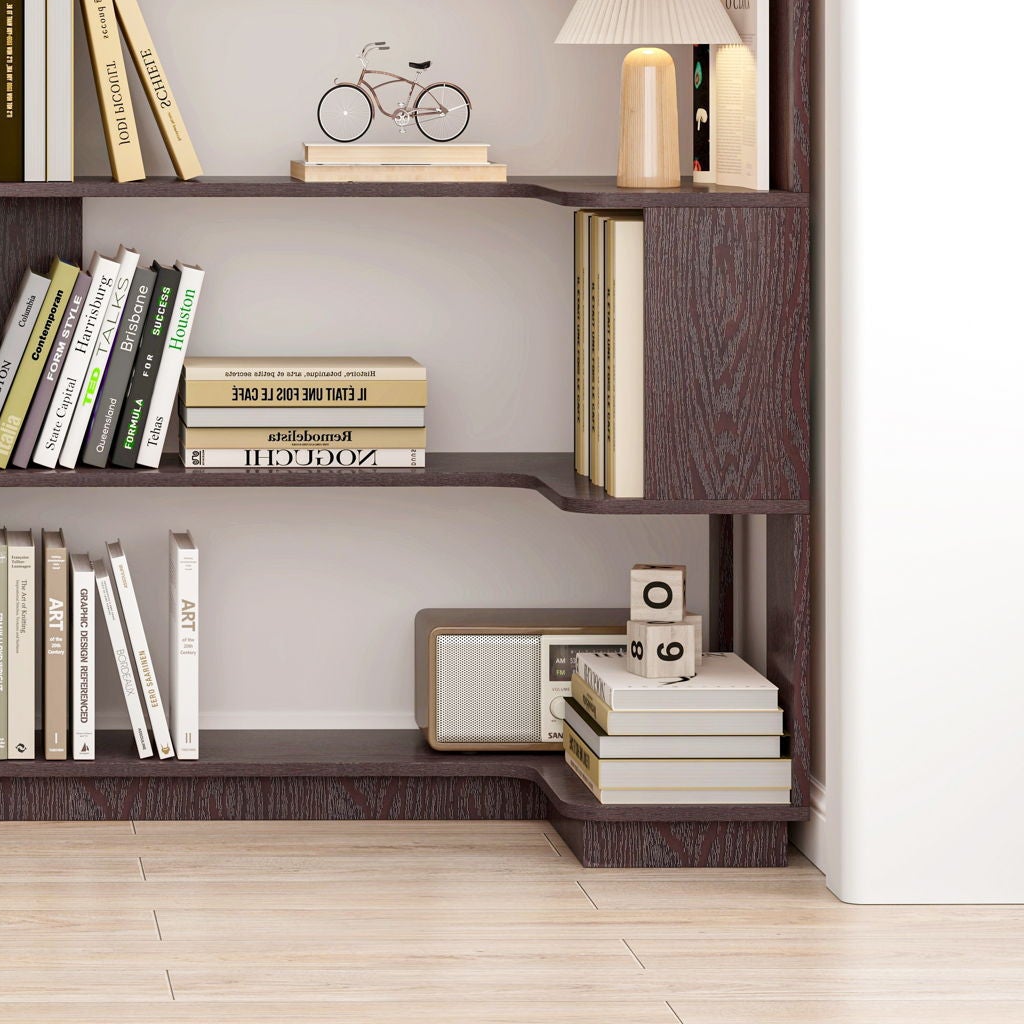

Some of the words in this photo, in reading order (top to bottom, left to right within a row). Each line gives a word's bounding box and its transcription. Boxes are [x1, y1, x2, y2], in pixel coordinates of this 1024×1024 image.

[18, 295, 37, 328] Columbia
[31, 289, 64, 361] Contemporan
[47, 341, 66, 381] FORM
[62, 295, 83, 337] STYLE
[82, 367, 101, 406] TED
[95, 277, 129, 355] TALKS
[45, 421, 63, 451] State
[56, 378, 77, 418] Capital
[75, 275, 113, 354] Harrisburg
[96, 398, 117, 453] Queensland
[120, 285, 149, 352] Brisbane
[124, 398, 144, 449] FORMULA
[143, 354, 154, 377] FOR
[152, 286, 171, 336] SUCCESS
[146, 415, 163, 447] Tehas
[169, 288, 196, 351] Houston
[20, 580, 28, 591] The
[20, 592, 28, 603] Art
[20, 611, 28, 634] Knitting
[48, 598, 64, 631] ART
[80, 588, 88, 628] GRAPHIC
[182, 599, 195, 632] ART
[80, 630, 88, 663] DESIGN
[631, 640, 644, 660] 8
[117, 649, 135, 696] BORDEAUX
[138, 650, 154, 687] SAARINEN
[80, 665, 88, 724] REFERENCED
[148, 688, 159, 708] EERO
